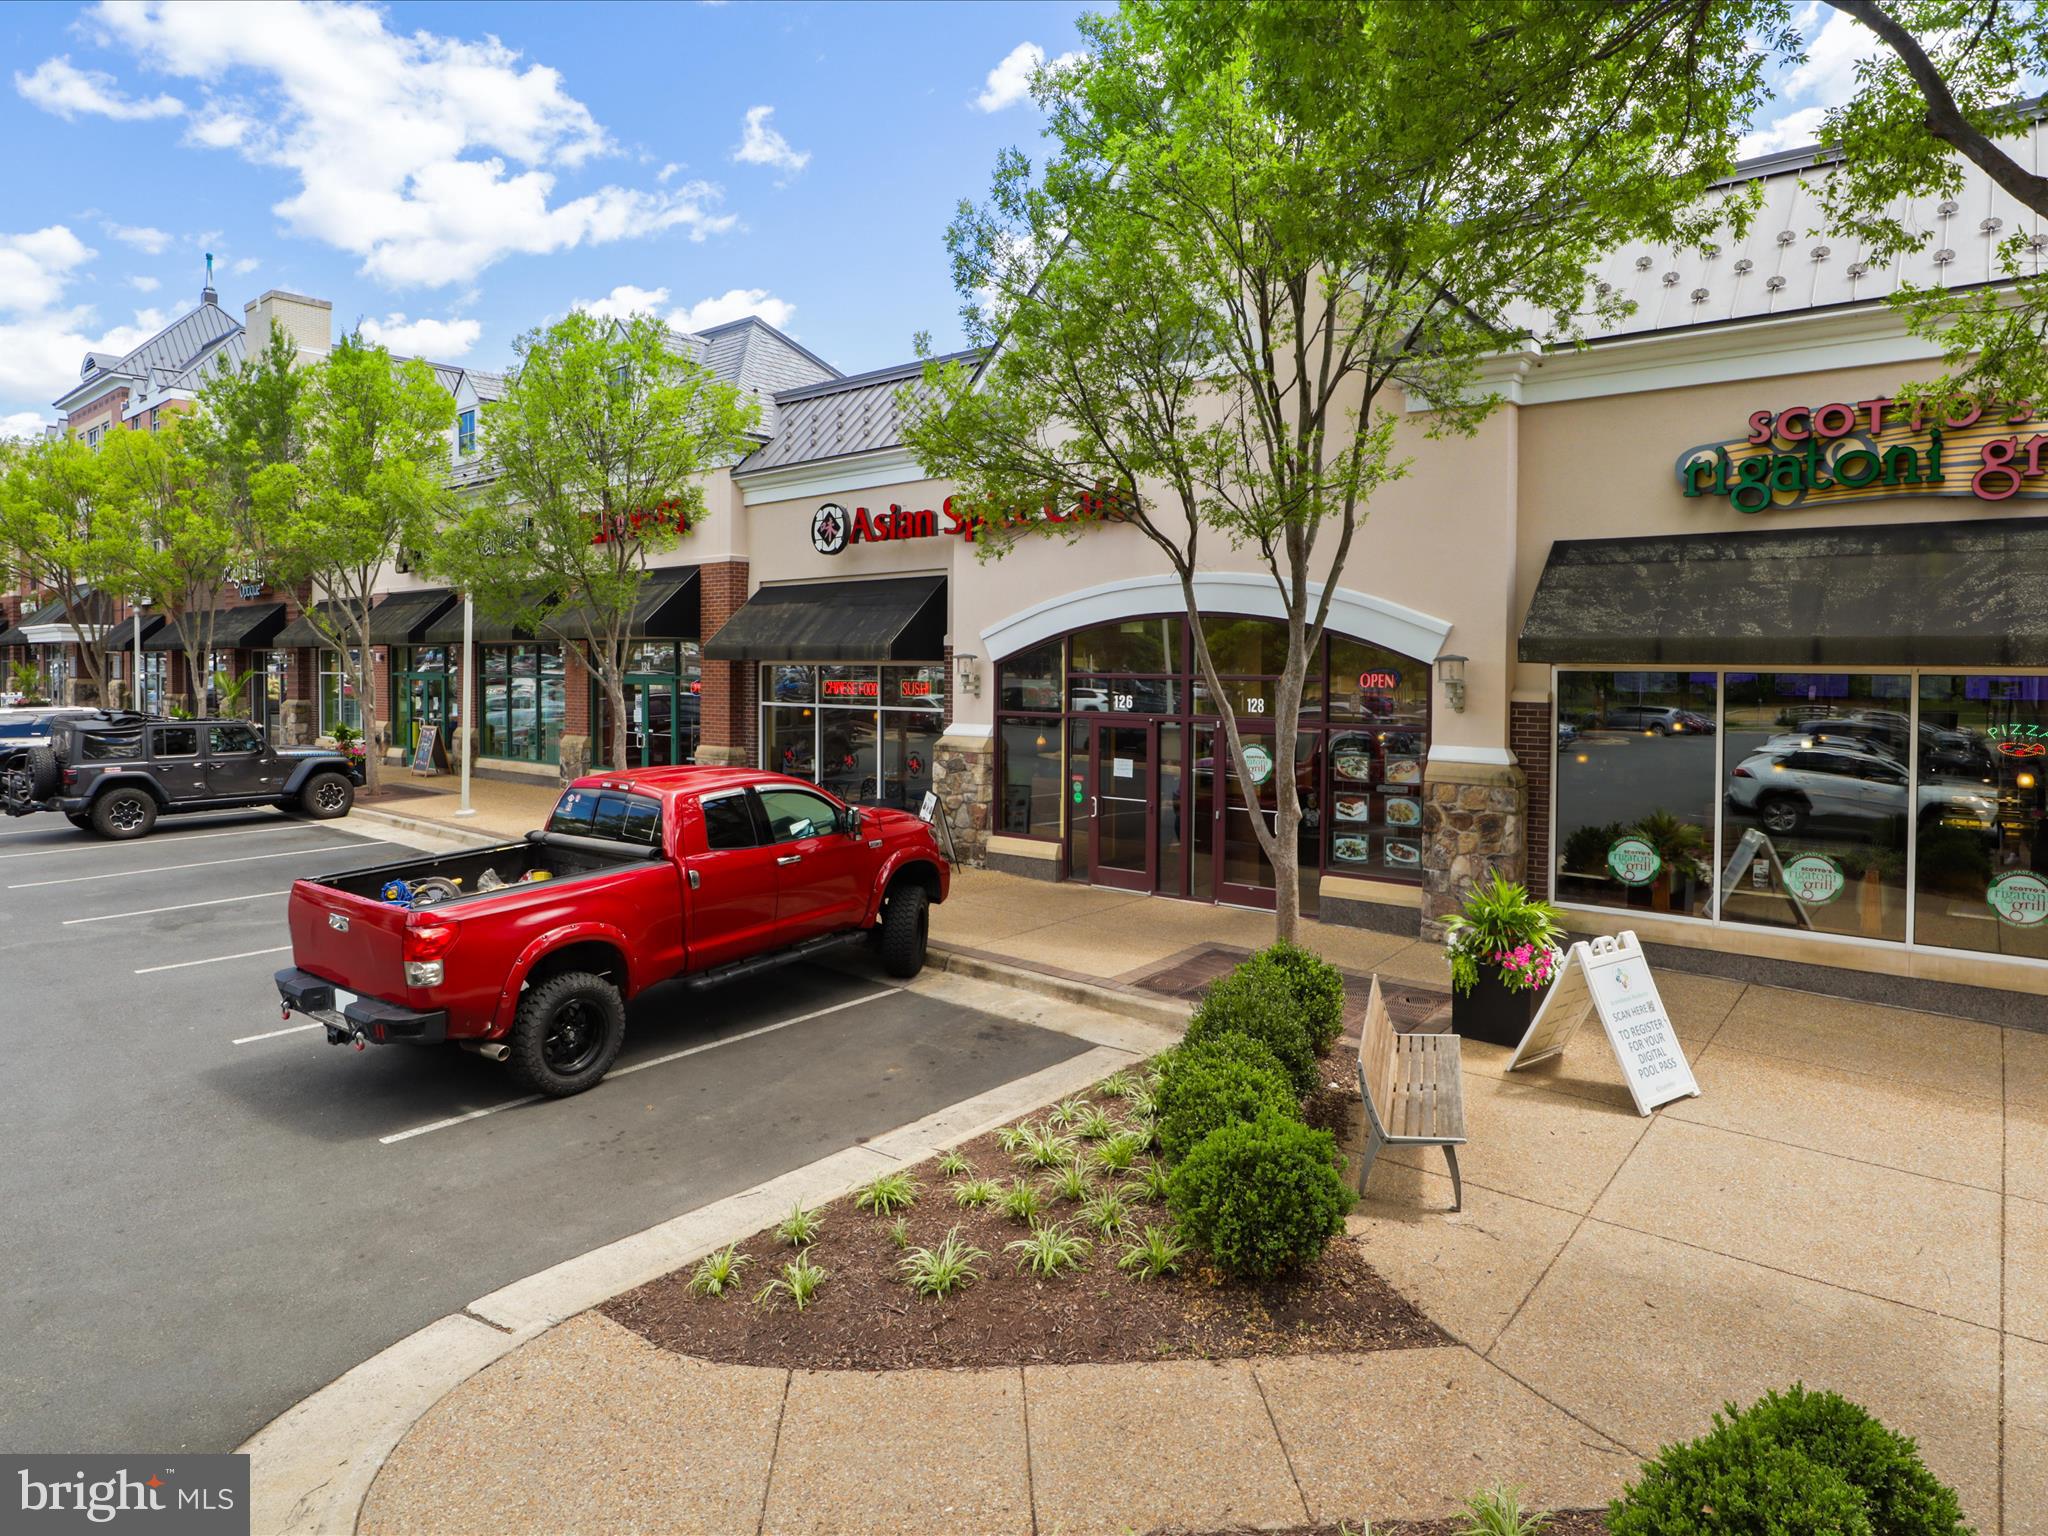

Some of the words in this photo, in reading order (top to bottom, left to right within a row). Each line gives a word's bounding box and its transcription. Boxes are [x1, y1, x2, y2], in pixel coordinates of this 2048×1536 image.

[1683, 427, 1946, 513] rigatoni
[849, 504, 937, 544] Asian
[824, 681, 858, 695] CHINESE
[902, 682, 930, 696] SUSHI
[1360, 673, 1394, 688] OPEN
[1114, 695, 1133, 709] 126
[1247, 698, 1265, 713] 128
[1624, 860, 1651, 881] grill
[1789, 870, 1837, 884] rigatoni
[1802, 878, 1833, 900] grill
[2009, 886, 2046, 894] SCOTTO'S
[2009, 897, 2046, 922] grill
[1612, 1009, 1631, 1023] SCAN
[1631, 1004, 1648, 1017] HERE
[1618, 1028, 1630, 1041] TO
[1630, 1019, 1664, 1037] REGISTER
[1628, 1040, 1646, 1053] FOR
[1645, 1033, 1666, 1048] YOUR
[1637, 1047, 1667, 1065] DIGITAL
[1637, 1065, 1660, 1079] POOL
[1659, 1057, 1677, 1072] PASS
